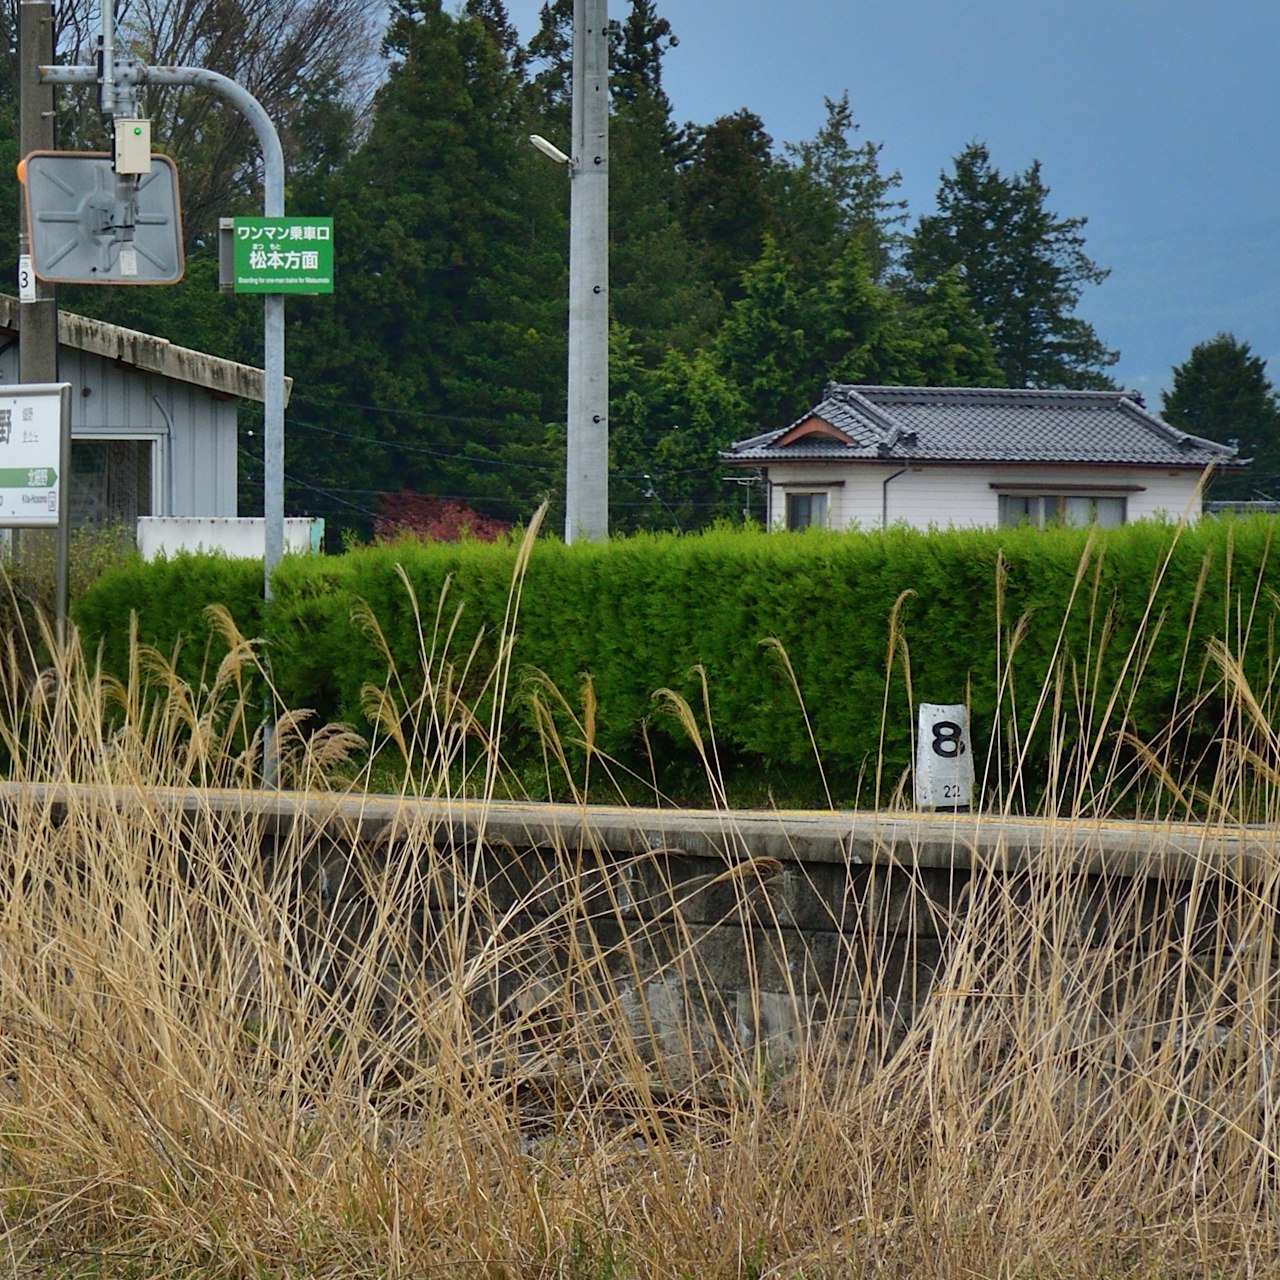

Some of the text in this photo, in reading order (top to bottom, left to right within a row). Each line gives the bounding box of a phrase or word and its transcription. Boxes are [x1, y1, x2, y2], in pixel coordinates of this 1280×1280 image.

[238, 226, 330, 240] ワンマン乗車口
[249, 251, 319, 269] 松本方面
[21, 271, 29, 288] 3
[932, 721, 965, 758] 8
